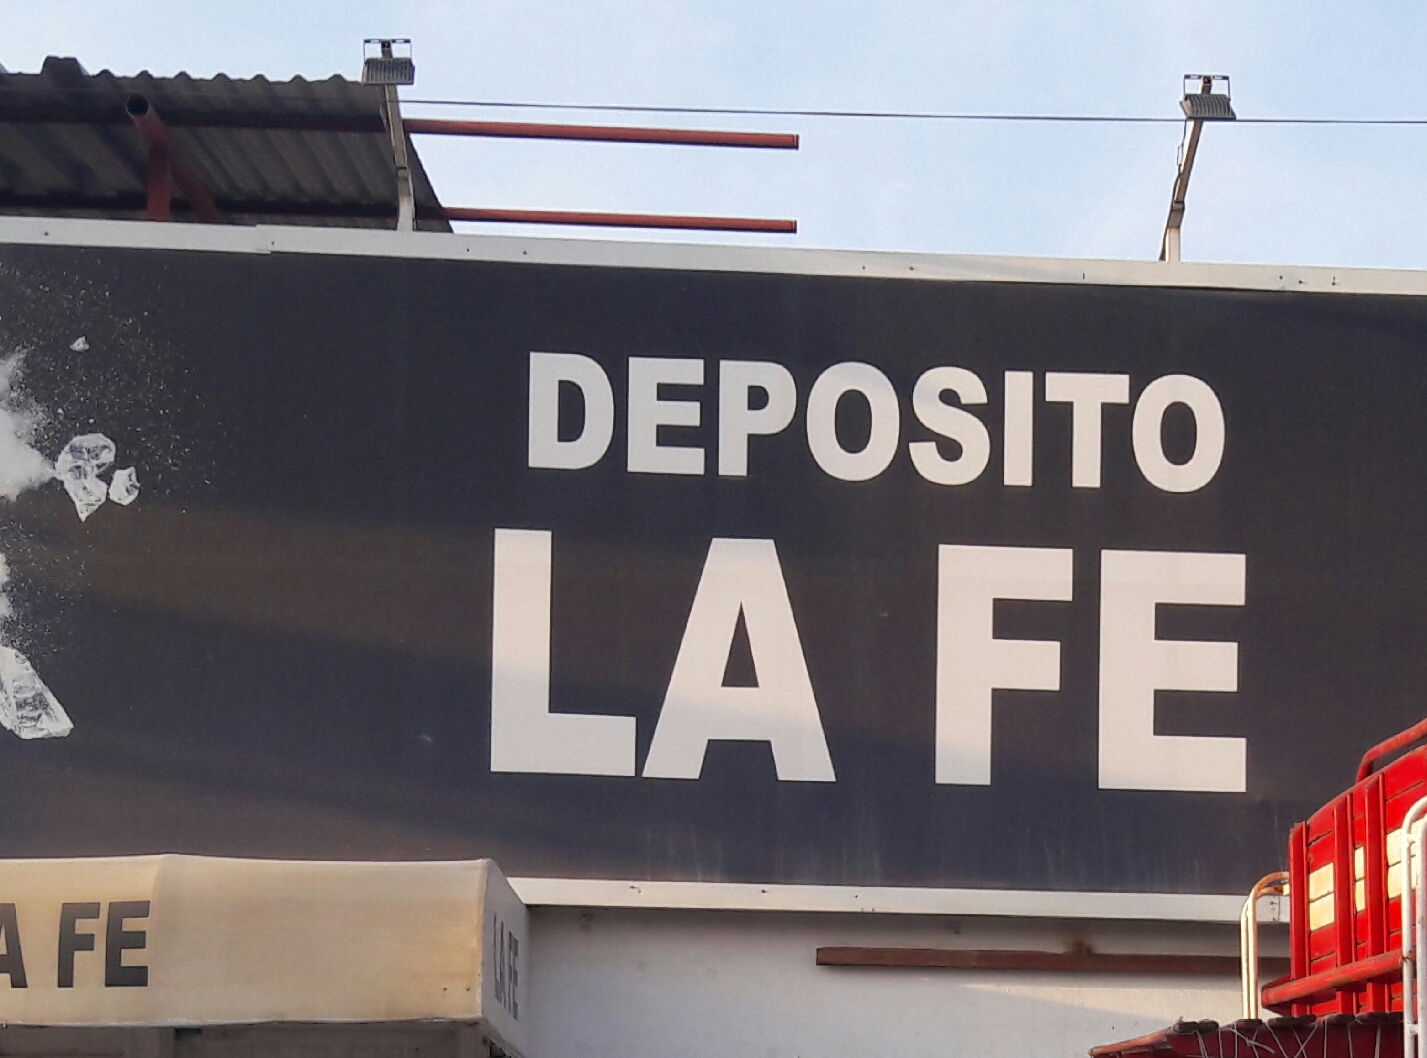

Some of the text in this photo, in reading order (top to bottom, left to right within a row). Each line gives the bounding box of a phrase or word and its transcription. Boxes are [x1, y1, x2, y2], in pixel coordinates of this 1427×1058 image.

[528, 350, 1226, 493] DEPOSITO
[489, 528, 1248, 794] LA FE
[57, 900, 151, 988] FE
[493, 910, 519, 1021] LA FE
